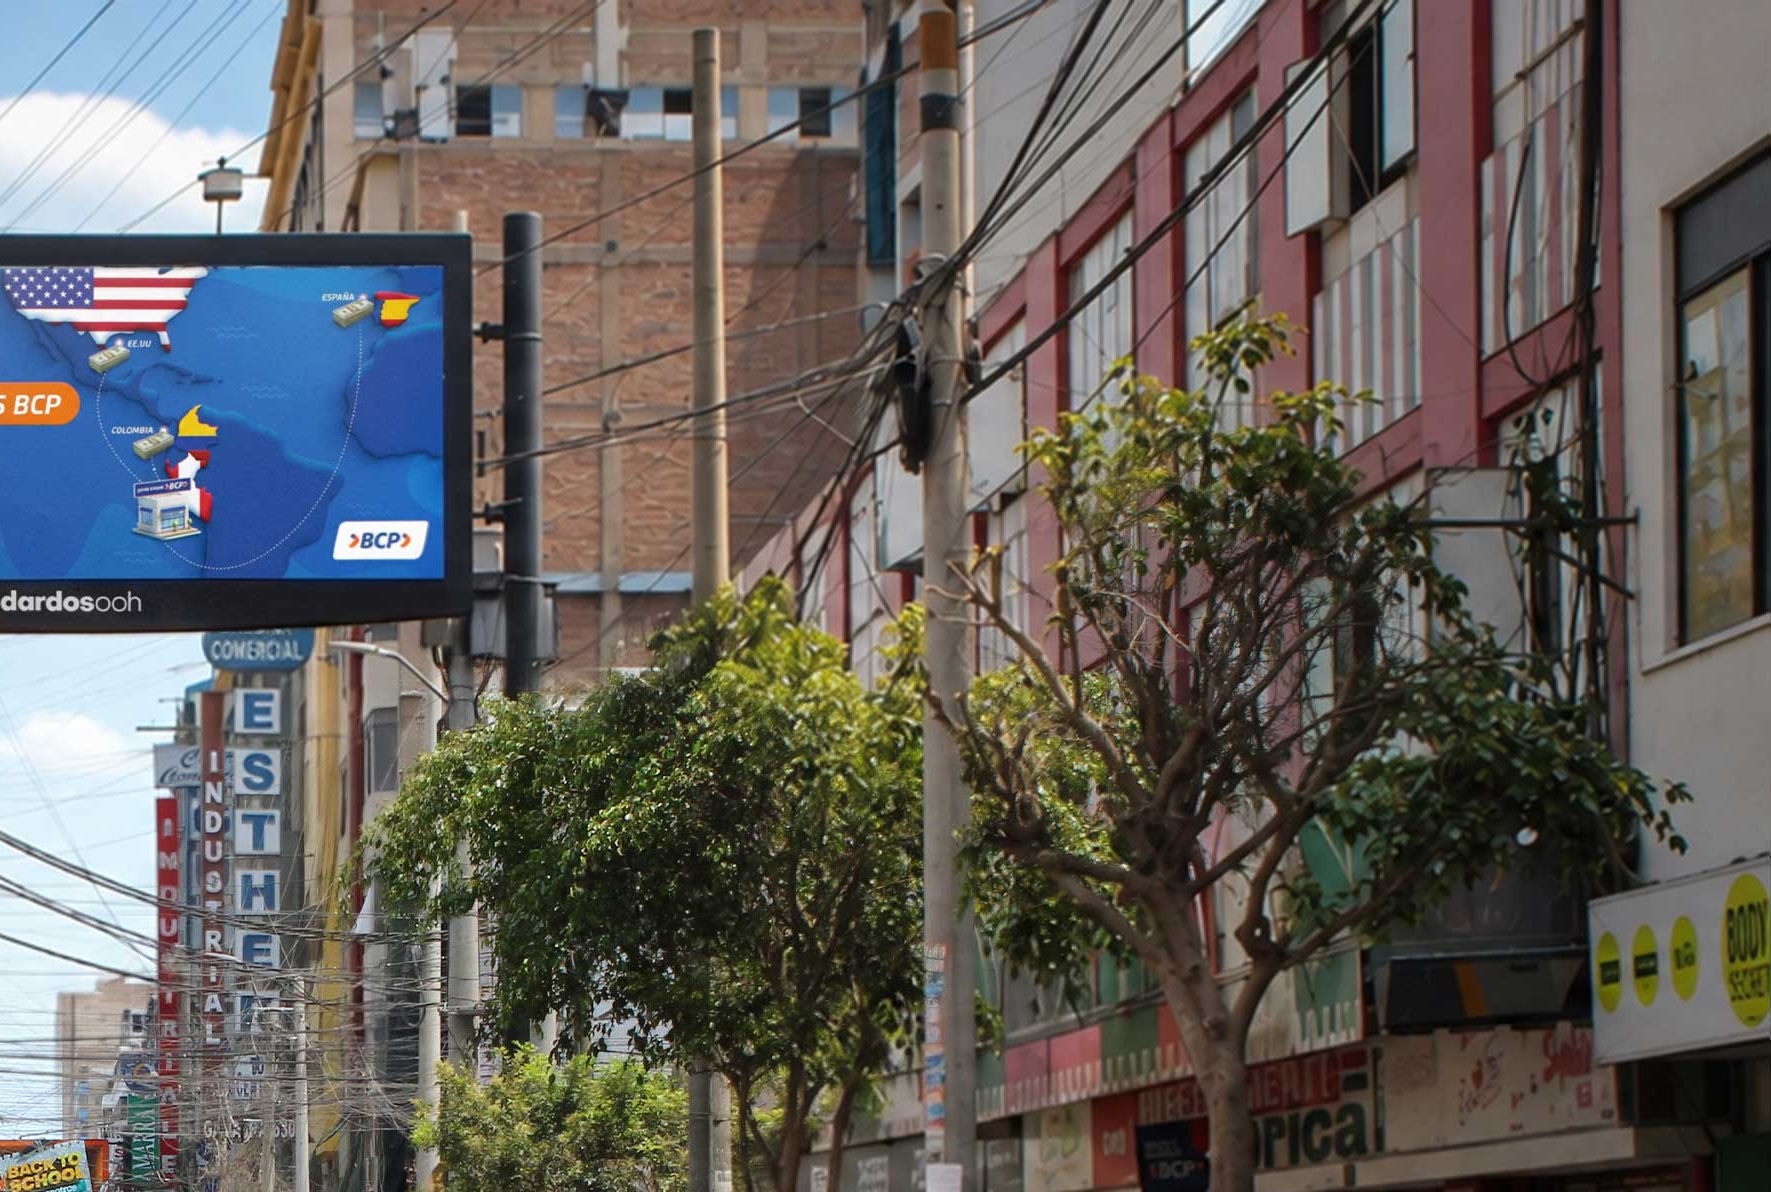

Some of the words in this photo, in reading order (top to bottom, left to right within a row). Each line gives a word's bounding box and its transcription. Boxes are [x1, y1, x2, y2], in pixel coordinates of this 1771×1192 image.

[322, 292, 355, 301] ESPAÑA
[13, 394, 62, 415] BCP
[111, 426, 154, 435] COLOMBIA
[360, 532, 401, 549] BCP
[0, 590, 142, 612] dardosooh
[211, 640, 303, 661] COMERCIAL
[204, 751, 223, 1045] INDUSTRIAL
[8, 1159, 54, 1179] BACK
[59, 1152, 80, 1168] TO
